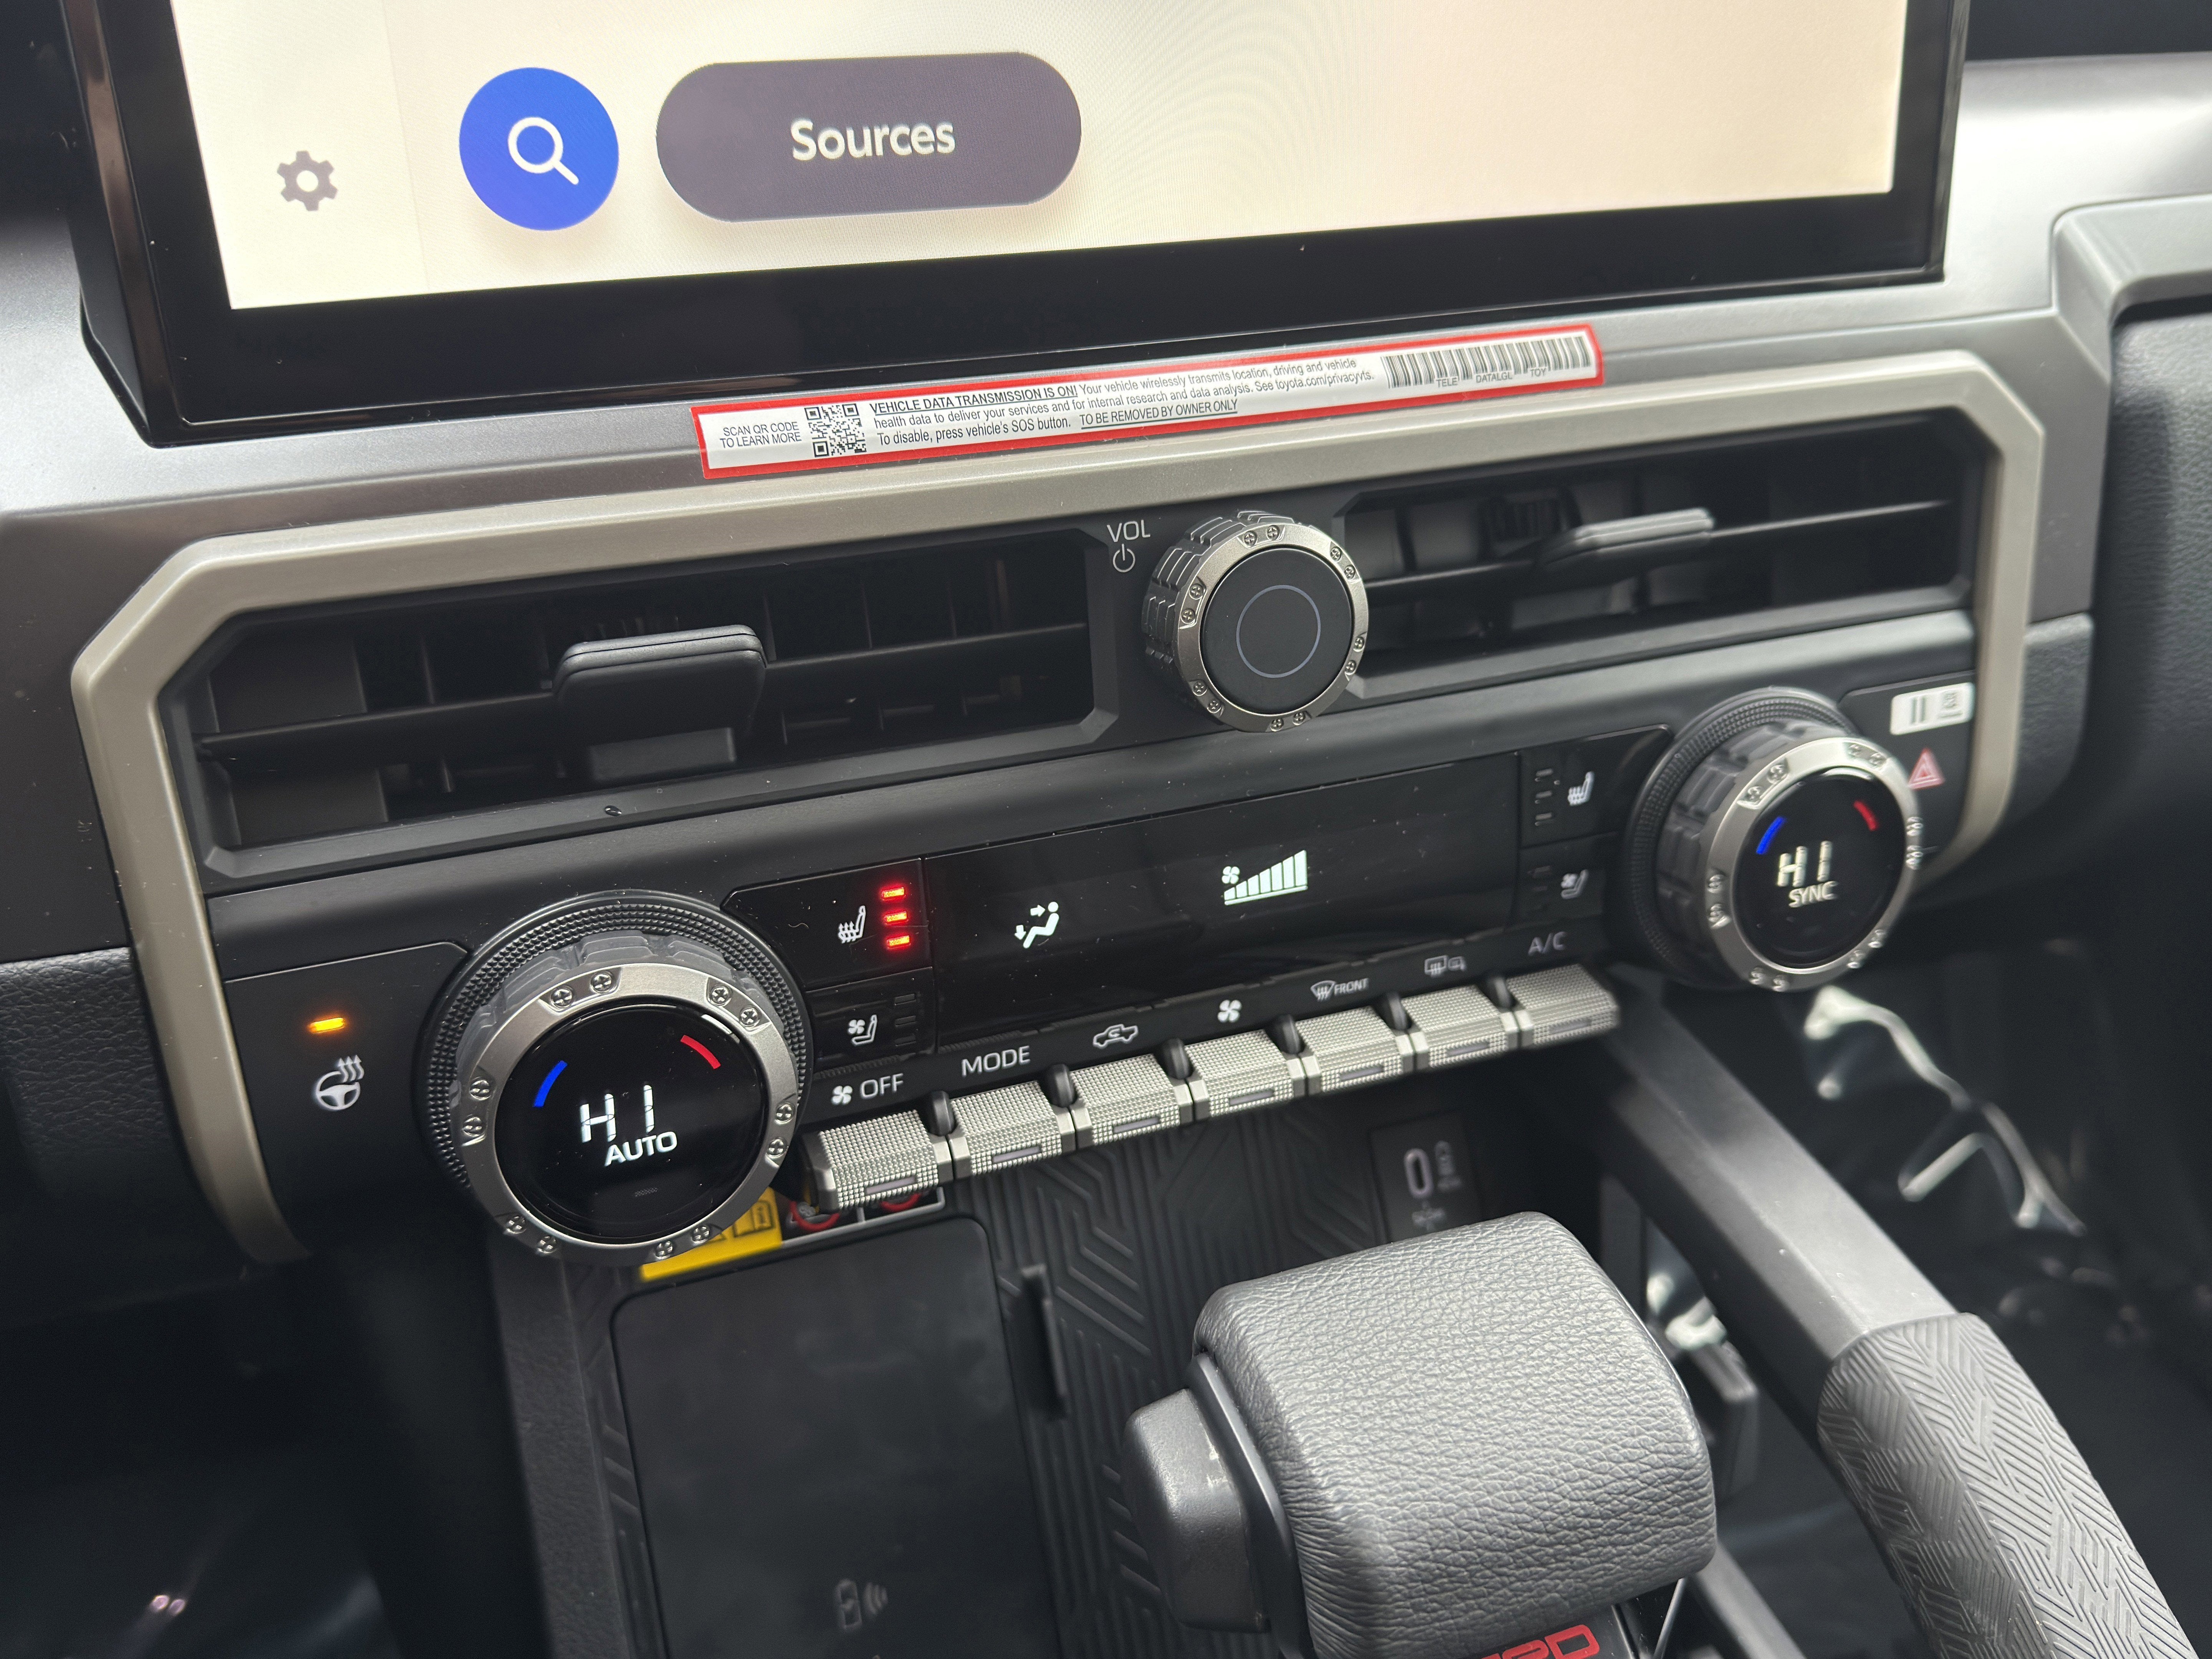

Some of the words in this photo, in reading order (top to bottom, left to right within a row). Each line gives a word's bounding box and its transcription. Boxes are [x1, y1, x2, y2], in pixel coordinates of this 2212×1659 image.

[790, 118, 955, 161] Sources
[869, 399, 921, 414] VEHICLE
[923, 397, 955, 409] DATA
[955, 389, 1042, 406] TRANSMISSION
[1044, 387, 1055, 398] IS
[1057, 385, 1078, 396] ON!
[1079, 384, 1102, 395] Your
[1104, 380, 1138, 392] vehicle
[1140, 375, 1185, 389] wirelessly
[1188, 371, 1230, 384] transmits
[1232, 368, 1272, 380] location,
[1273, 364, 1304, 376] driving
[1306, 361, 1323, 373] and
[1325, 358, 1356, 370] vehicle
[1436, 377, 1459, 388] TELE
[1476, 372, 1513, 383] DATALGL
[1530, 368, 1547, 377] TOY
[874, 416, 906, 429] health
[909, 414, 931, 426] data
[934, 413, 944, 423] to
[948, 410, 980, 422] deliver
[983, 408, 1005, 421] your
[1008, 404, 1049, 416] services
[1052, 400, 1070, 412] and
[1072, 399, 1085, 410] for
[1087, 395, 1124, 408] internal
[1126, 391, 1167, 405] research
[1170, 389, 1187, 400] and
[1190, 387, 1210, 398] data
[1213, 382, 1253, 397] analysis.
[1255, 381, 1274, 392] See
[1275, 370, 1374, 391] toyota.com/privacyvts.
[723, 426, 751, 436] SCAN
[753, 424, 769, 434] QR
[770, 422, 799, 432] CODE
[877, 432, 890, 445] To
[893, 429, 932, 444] disable,
[936, 427, 963, 443] press
[966, 422, 1008, 437] vehicle's
[1012, 418, 1035, 432] SOS
[1037, 417, 1071, 430] button.
[1080, 413, 1093, 426] TO
[1096, 412, 1109, 424] BE
[1111, 407, 1159, 422] REMOVED
[1161, 405, 1173, 417] BY
[1176, 402, 1212, 416] OWNER
[1214, 399, 1237, 412] ONLY
[720, 437, 734, 448] TO
[736, 435, 770, 447] LEARN
[772, 432, 802, 444] MORE
[1106, 520, 1151, 543] VOL
[1777, 840, 1833, 887] HI
[1789, 881, 1838, 907] SYNC
[1528, 931, 1568, 956] A/C
[1333, 978, 1369, 995] FRONT
[962, 1045, 1031, 1077] MODE
[860, 1073, 904, 1099] OFF
[579, 1084, 653, 1144] HI
[604, 1131, 678, 1167] AUTO
